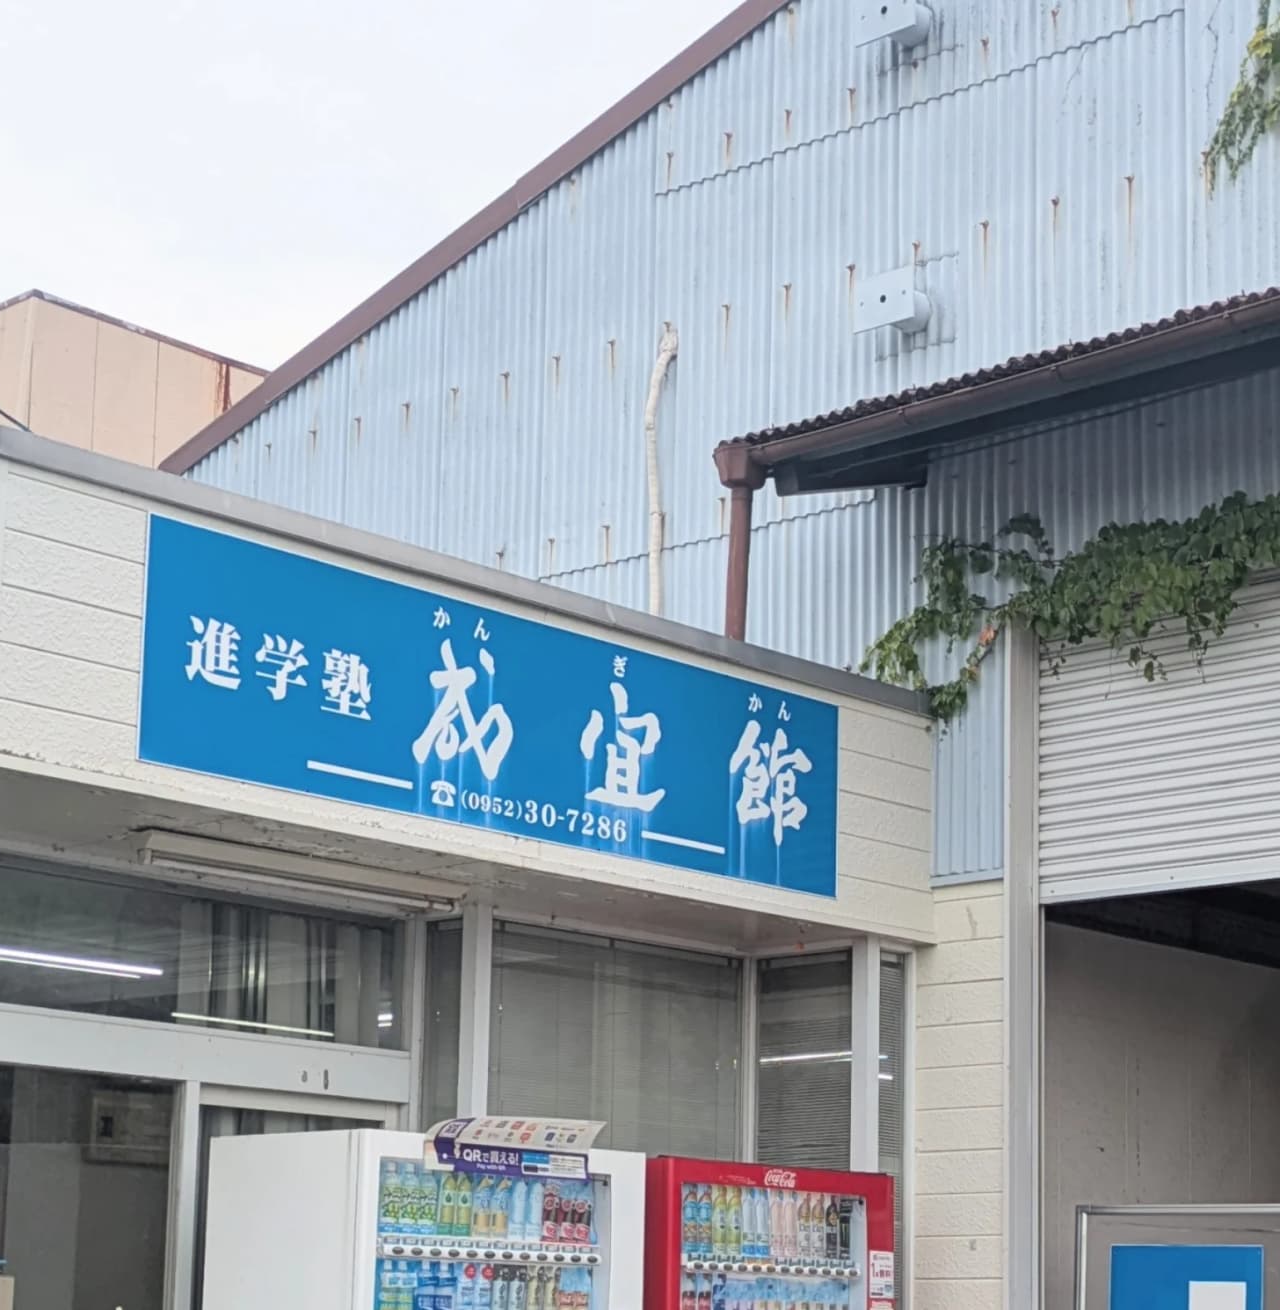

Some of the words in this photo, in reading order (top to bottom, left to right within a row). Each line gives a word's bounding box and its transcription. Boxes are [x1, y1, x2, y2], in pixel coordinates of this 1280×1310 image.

[184, 615, 372, 722] 進学塾
[432, 606, 491, 642] かん
[611, 654, 628, 678] ぎ
[748, 693, 791, 722] かん
[460, 790, 626, 843] (0952)30-7286
